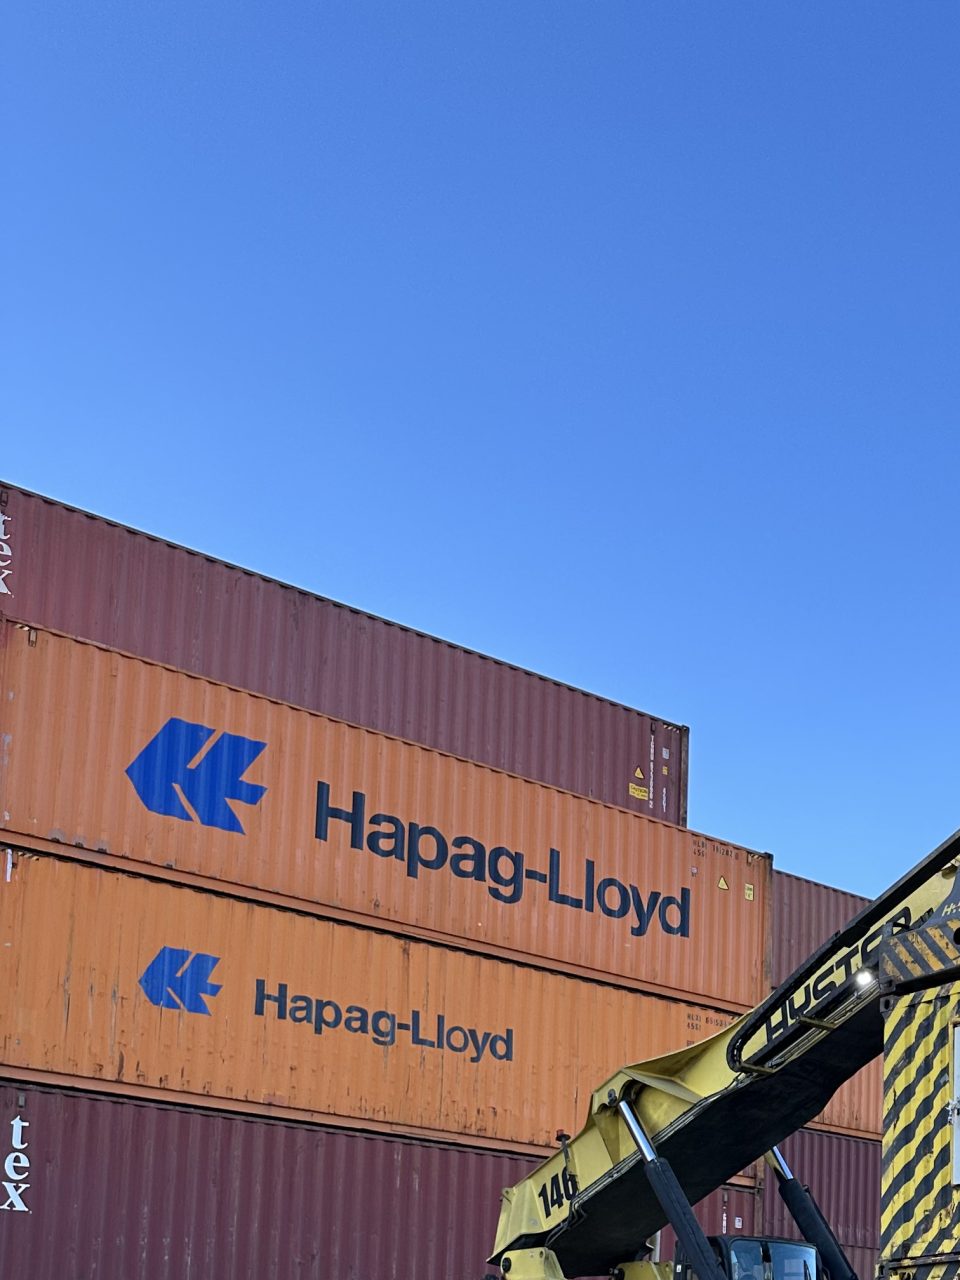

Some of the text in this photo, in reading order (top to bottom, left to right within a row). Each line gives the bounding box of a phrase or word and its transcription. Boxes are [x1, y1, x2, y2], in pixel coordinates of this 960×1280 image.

[315, 781, 690, 938] Hapag-Lloyd
[254, 979, 514, 1063] Hapag-Lloyd
[0, 1115, 31, 1212] tex
